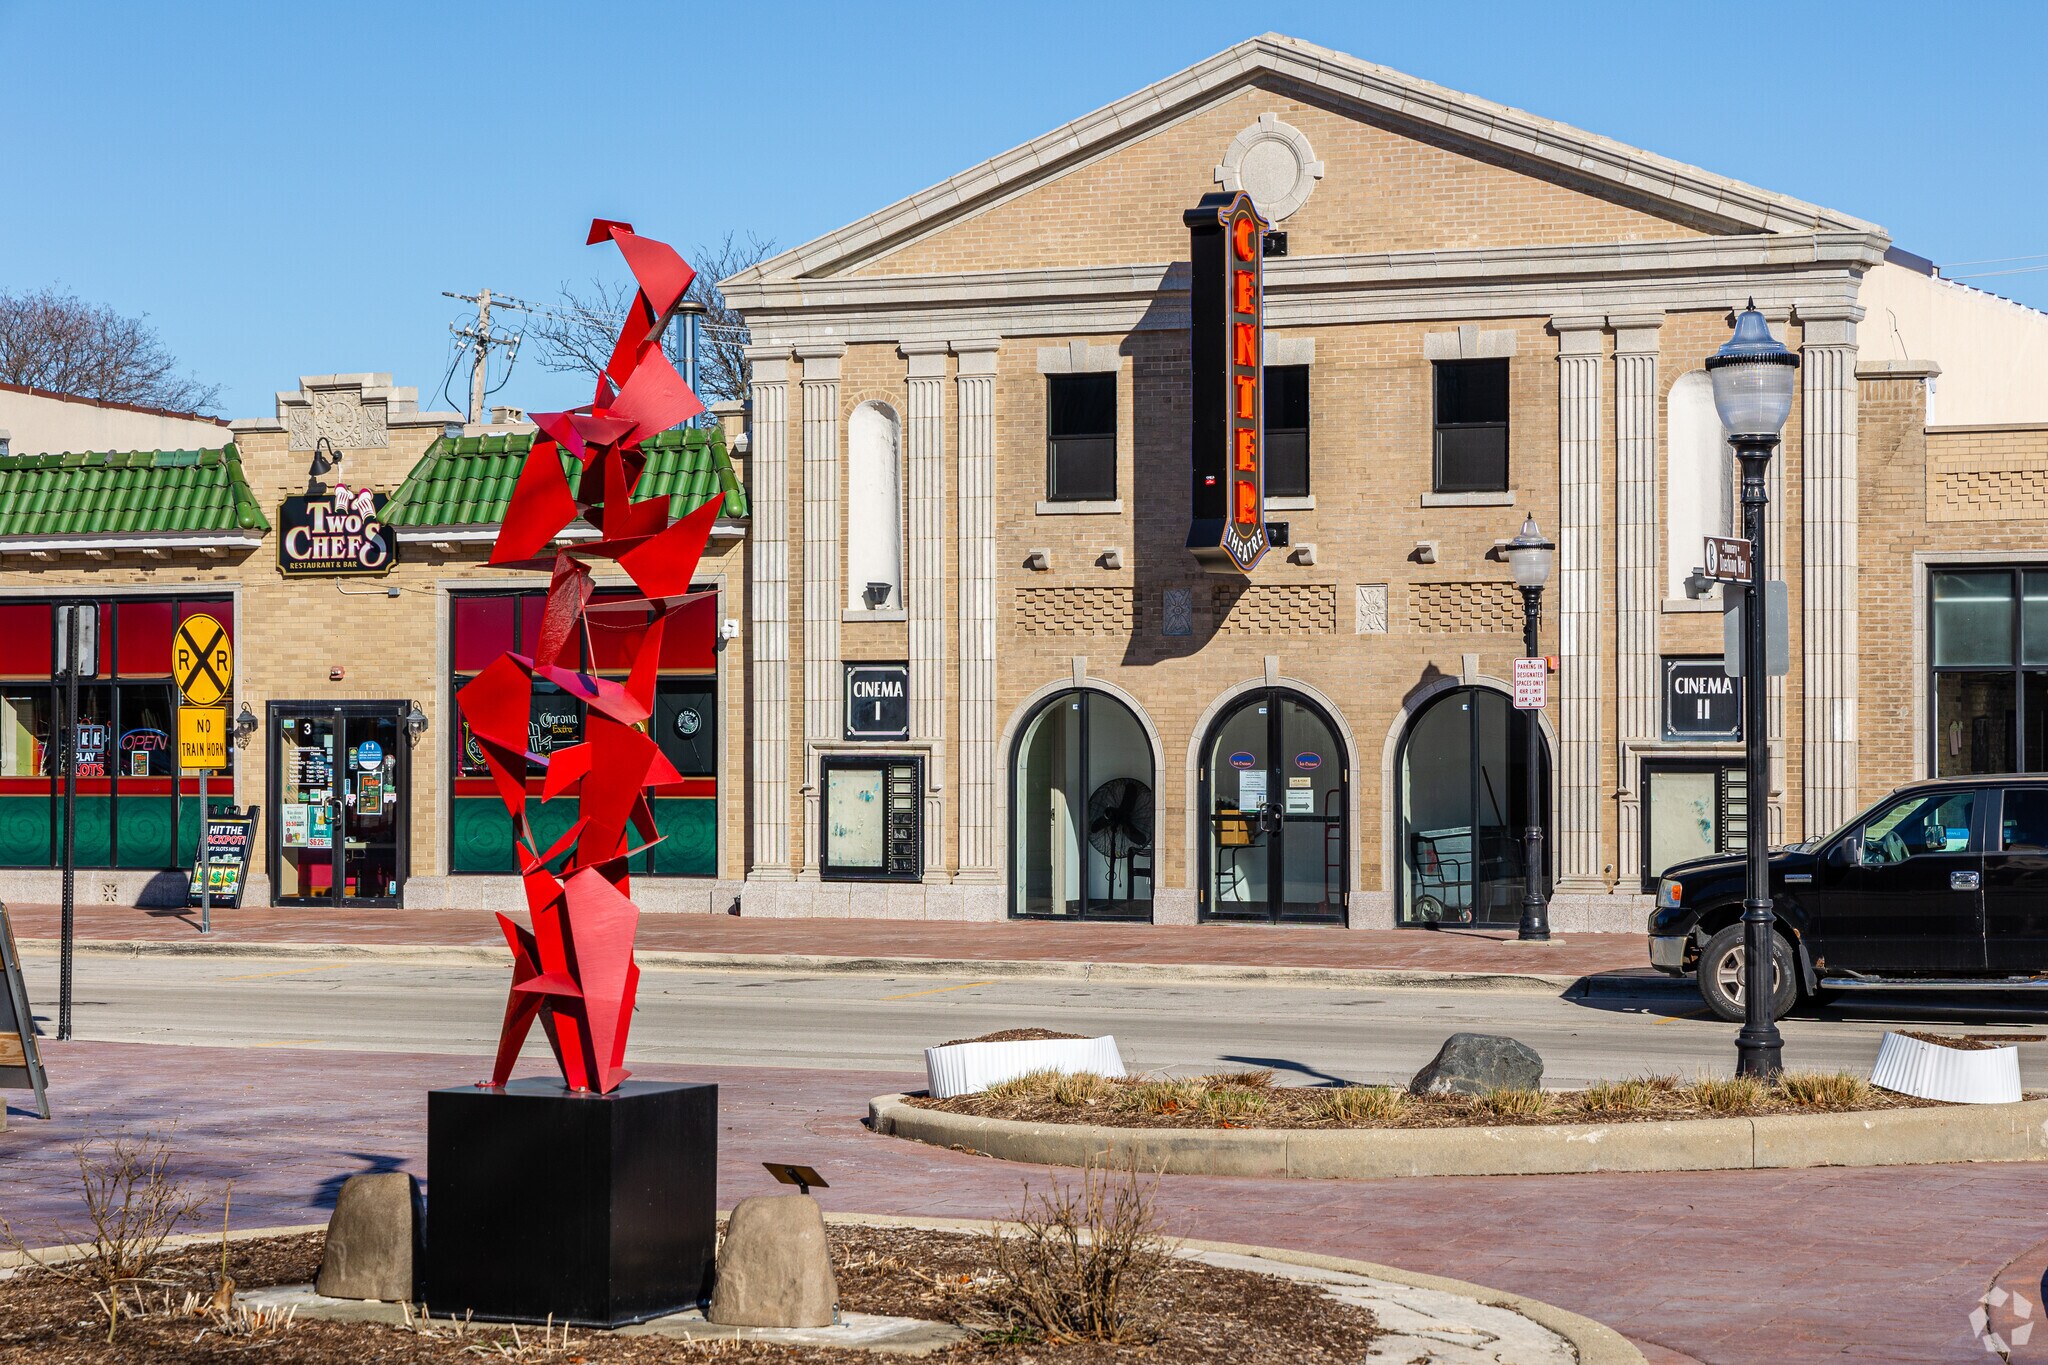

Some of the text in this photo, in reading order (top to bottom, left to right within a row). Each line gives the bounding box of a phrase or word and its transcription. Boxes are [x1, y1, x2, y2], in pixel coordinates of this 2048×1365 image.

[1233, 217, 1257, 524] CENTER
[306, 502, 362, 533] TWO
[285, 523, 387, 568] CHEFS
[1228, 526, 1263, 562] THEATRE
[290, 561, 335, 569] RESTAURANT
[343, 560, 358, 568] BAR
[1737, 555, 1747, 578] Way
[178, 650, 190, 670] R
[217, 650, 228, 671] R
[853, 681, 904, 698] CINEMA
[1674, 677, 1733, 695] CINEMA
[1697, 699, 1710, 720] II
[196, 719, 211, 733] NO
[540, 713, 578, 728] Corona
[304, 723, 312, 735] 3
[552, 725, 573, 734] Extra
[122, 735, 168, 750] OPEN
[182, 743, 224, 757] TRAIN HORN
[76, 763, 104, 776] LOTS
[209, 825, 244, 835] HIT THE
[207, 835, 246, 845] ACKPOT!
